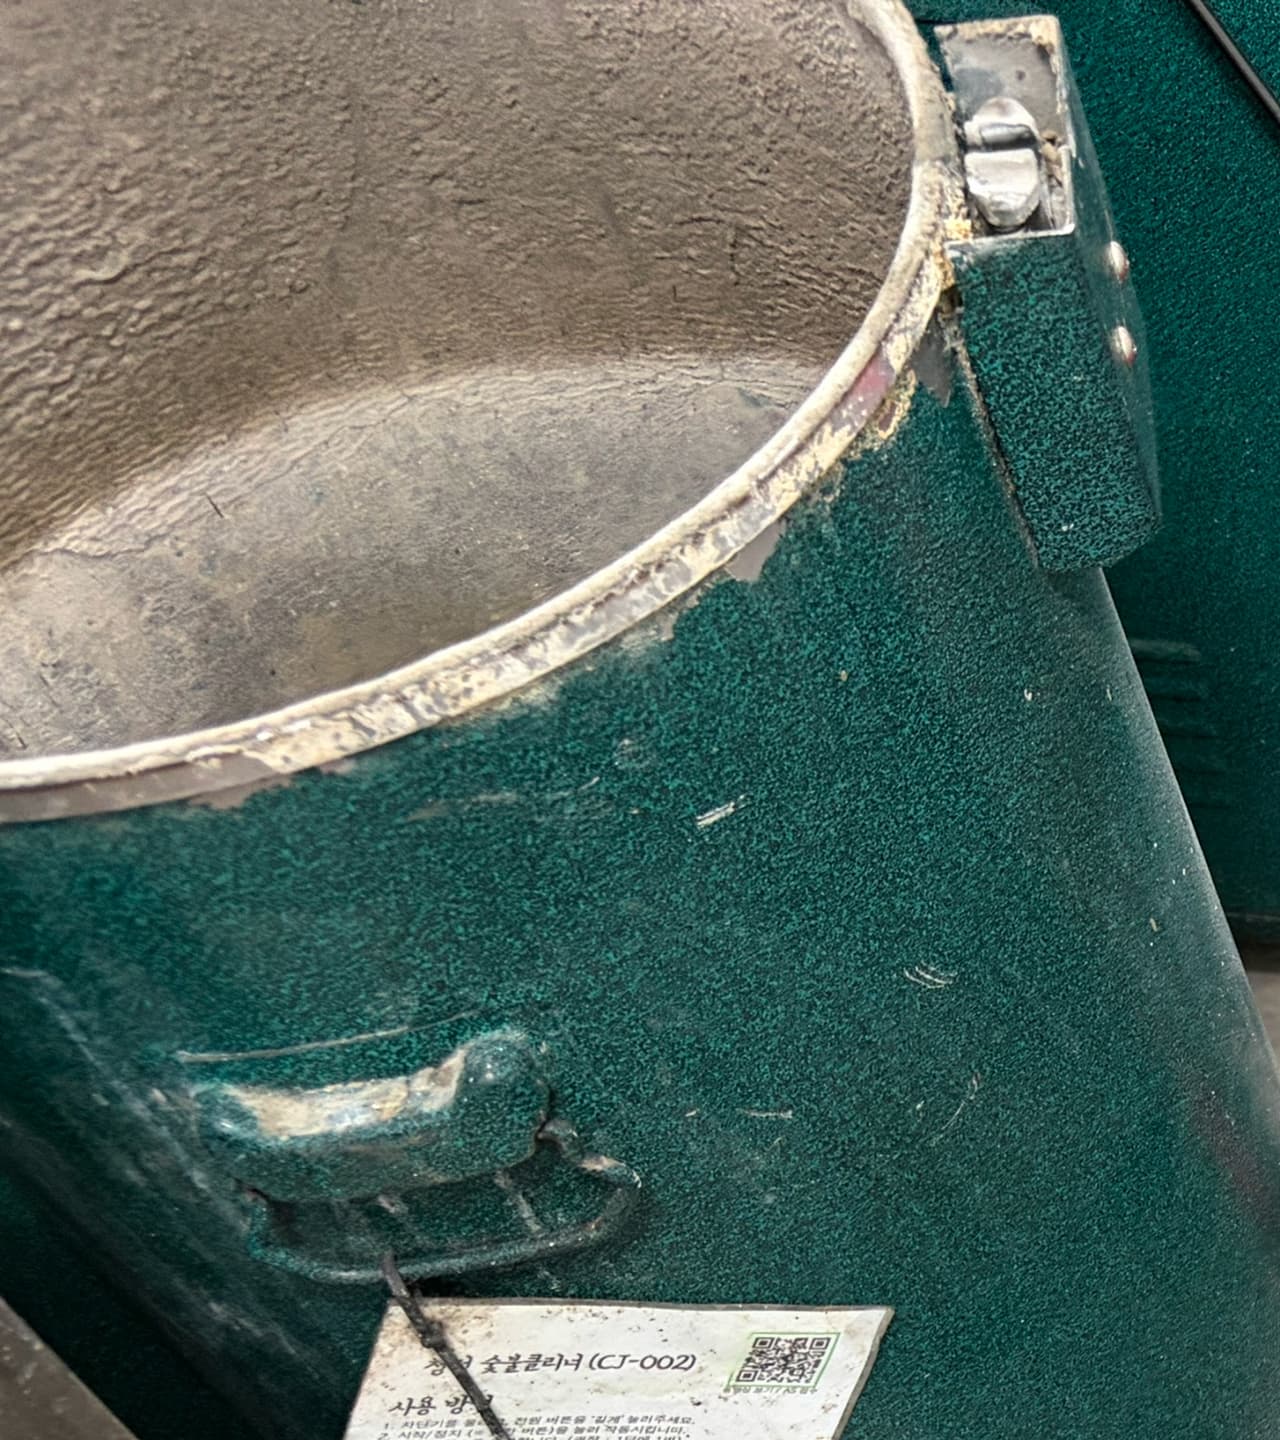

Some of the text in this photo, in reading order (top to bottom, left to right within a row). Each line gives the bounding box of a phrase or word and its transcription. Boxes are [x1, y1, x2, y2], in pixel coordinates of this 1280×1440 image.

[481, 1353, 583, 1374] 숯불클리너
[589, 1353, 696, 1371] (CJ-002)
[388, 1396, 436, 1416] 사용
